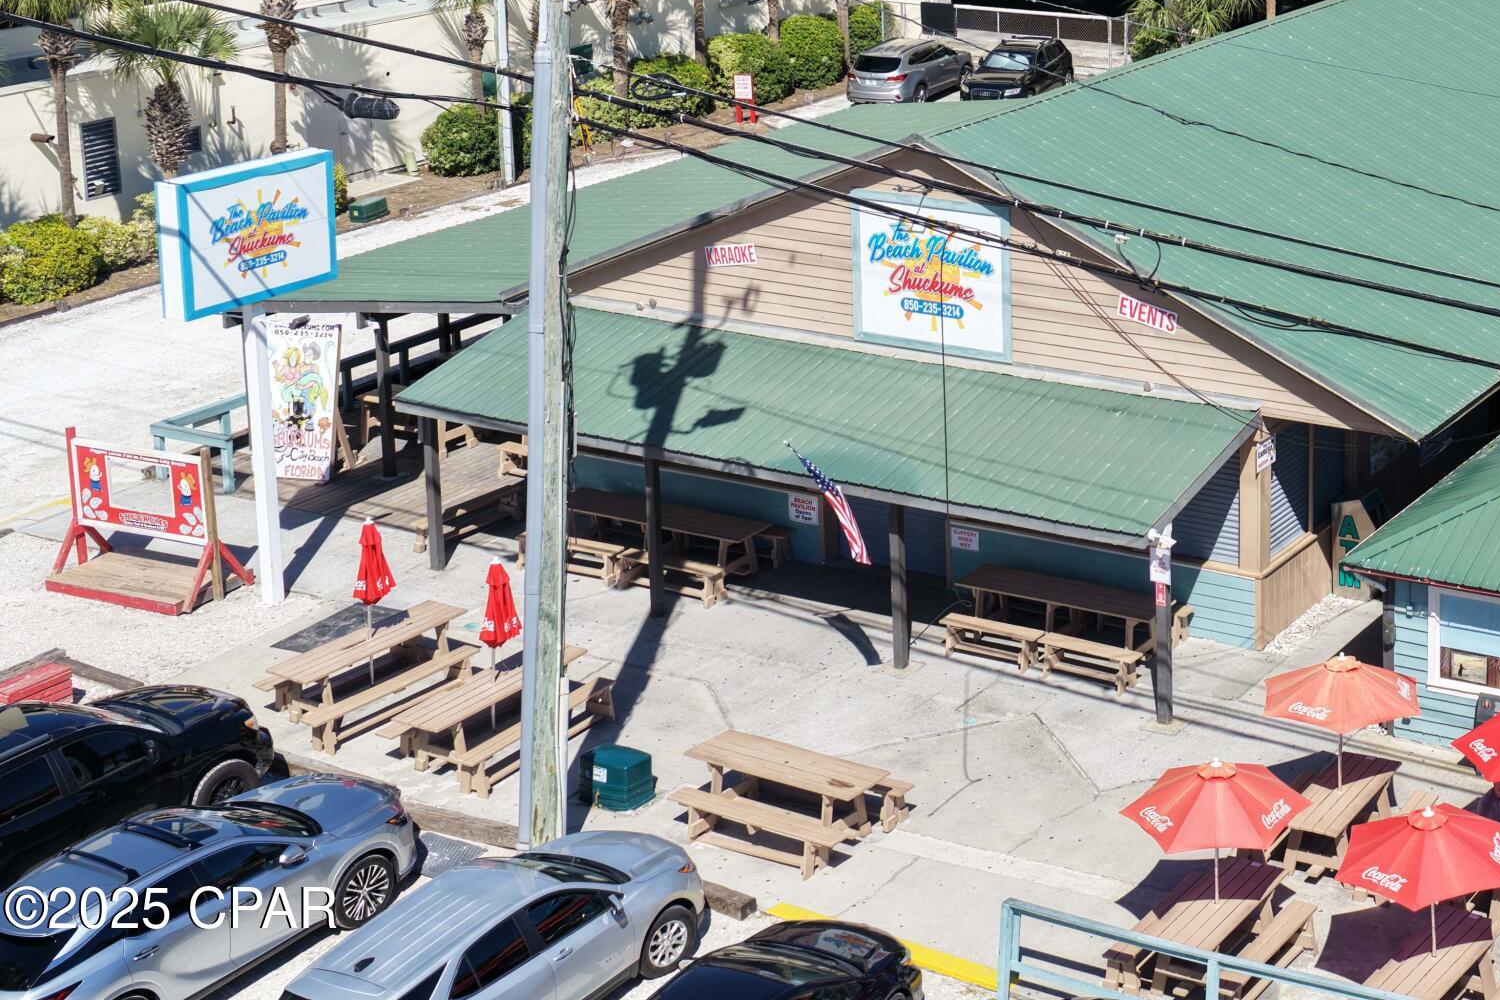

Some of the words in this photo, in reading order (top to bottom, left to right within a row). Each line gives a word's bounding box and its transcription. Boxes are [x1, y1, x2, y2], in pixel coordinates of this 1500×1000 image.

[227, 203, 243, 220] The
[210, 210, 254, 245] Beach
[255, 202, 308, 226] Pavilion
[890, 220, 910, 241] The
[228, 232, 295, 263] Shuckums
[705, 245, 756, 266] KARAOKE
[867, 233, 922, 263] Beach
[926, 236, 994, 276] Pavilion
[914, 263, 925, 273] at
[888, 264, 974, 300] Shuckums
[903, 299, 961, 317] 850-235-3214
[1120, 296, 1176, 332] EVENTS
[790, 502, 816, 512] PAVILION
[793, 497, 813, 505] BEACH
